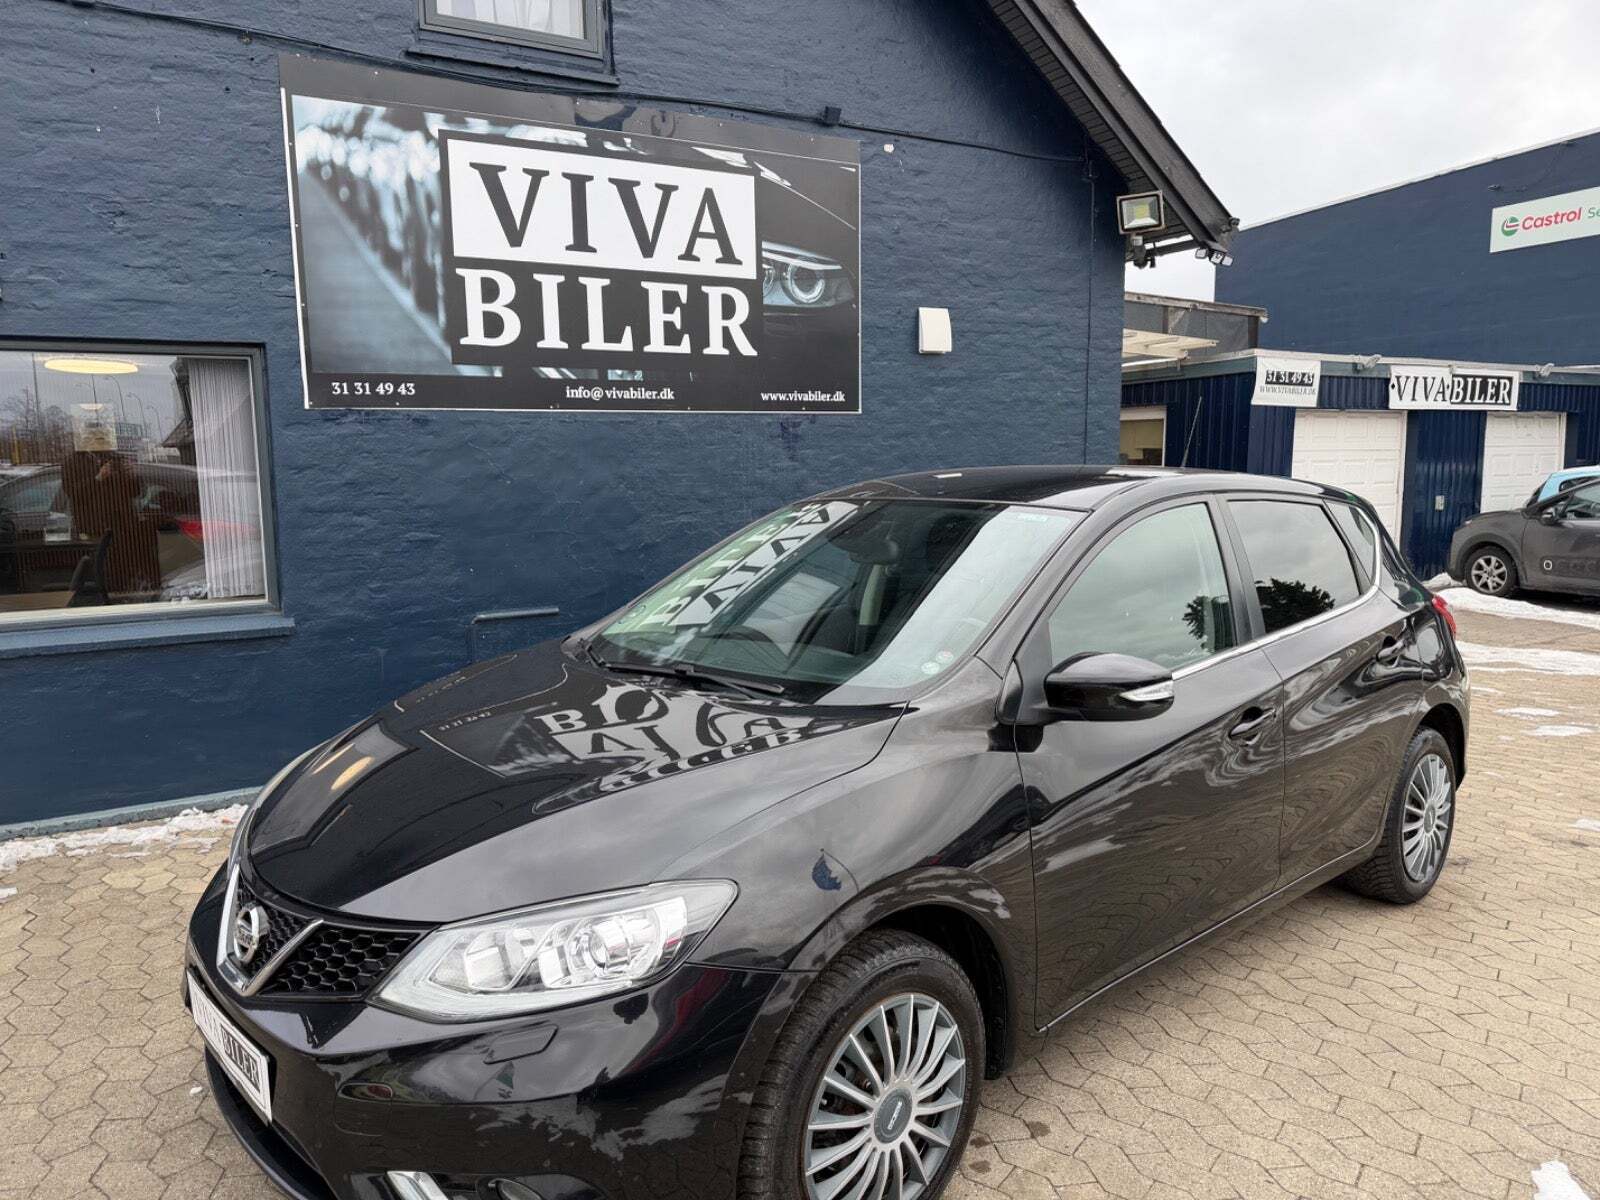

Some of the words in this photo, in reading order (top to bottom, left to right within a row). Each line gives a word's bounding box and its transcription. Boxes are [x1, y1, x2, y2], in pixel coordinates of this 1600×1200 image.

[469, 161, 743, 266] VIVA
[1521, 206, 1582, 231] Castrol
[455, 267, 758, 356] BILER
[331, 382, 349, 395] 31
[354, 382, 371, 395] 31
[375, 382, 394, 395] 49
[397, 383, 416, 396] 43
[760, 390, 846, 402] www.vivabiler.dk
[1395, 375, 1447, 402] VIVA
[1451, 377, 1510, 403] BILER
[221, 1028, 259, 1087] BILER
